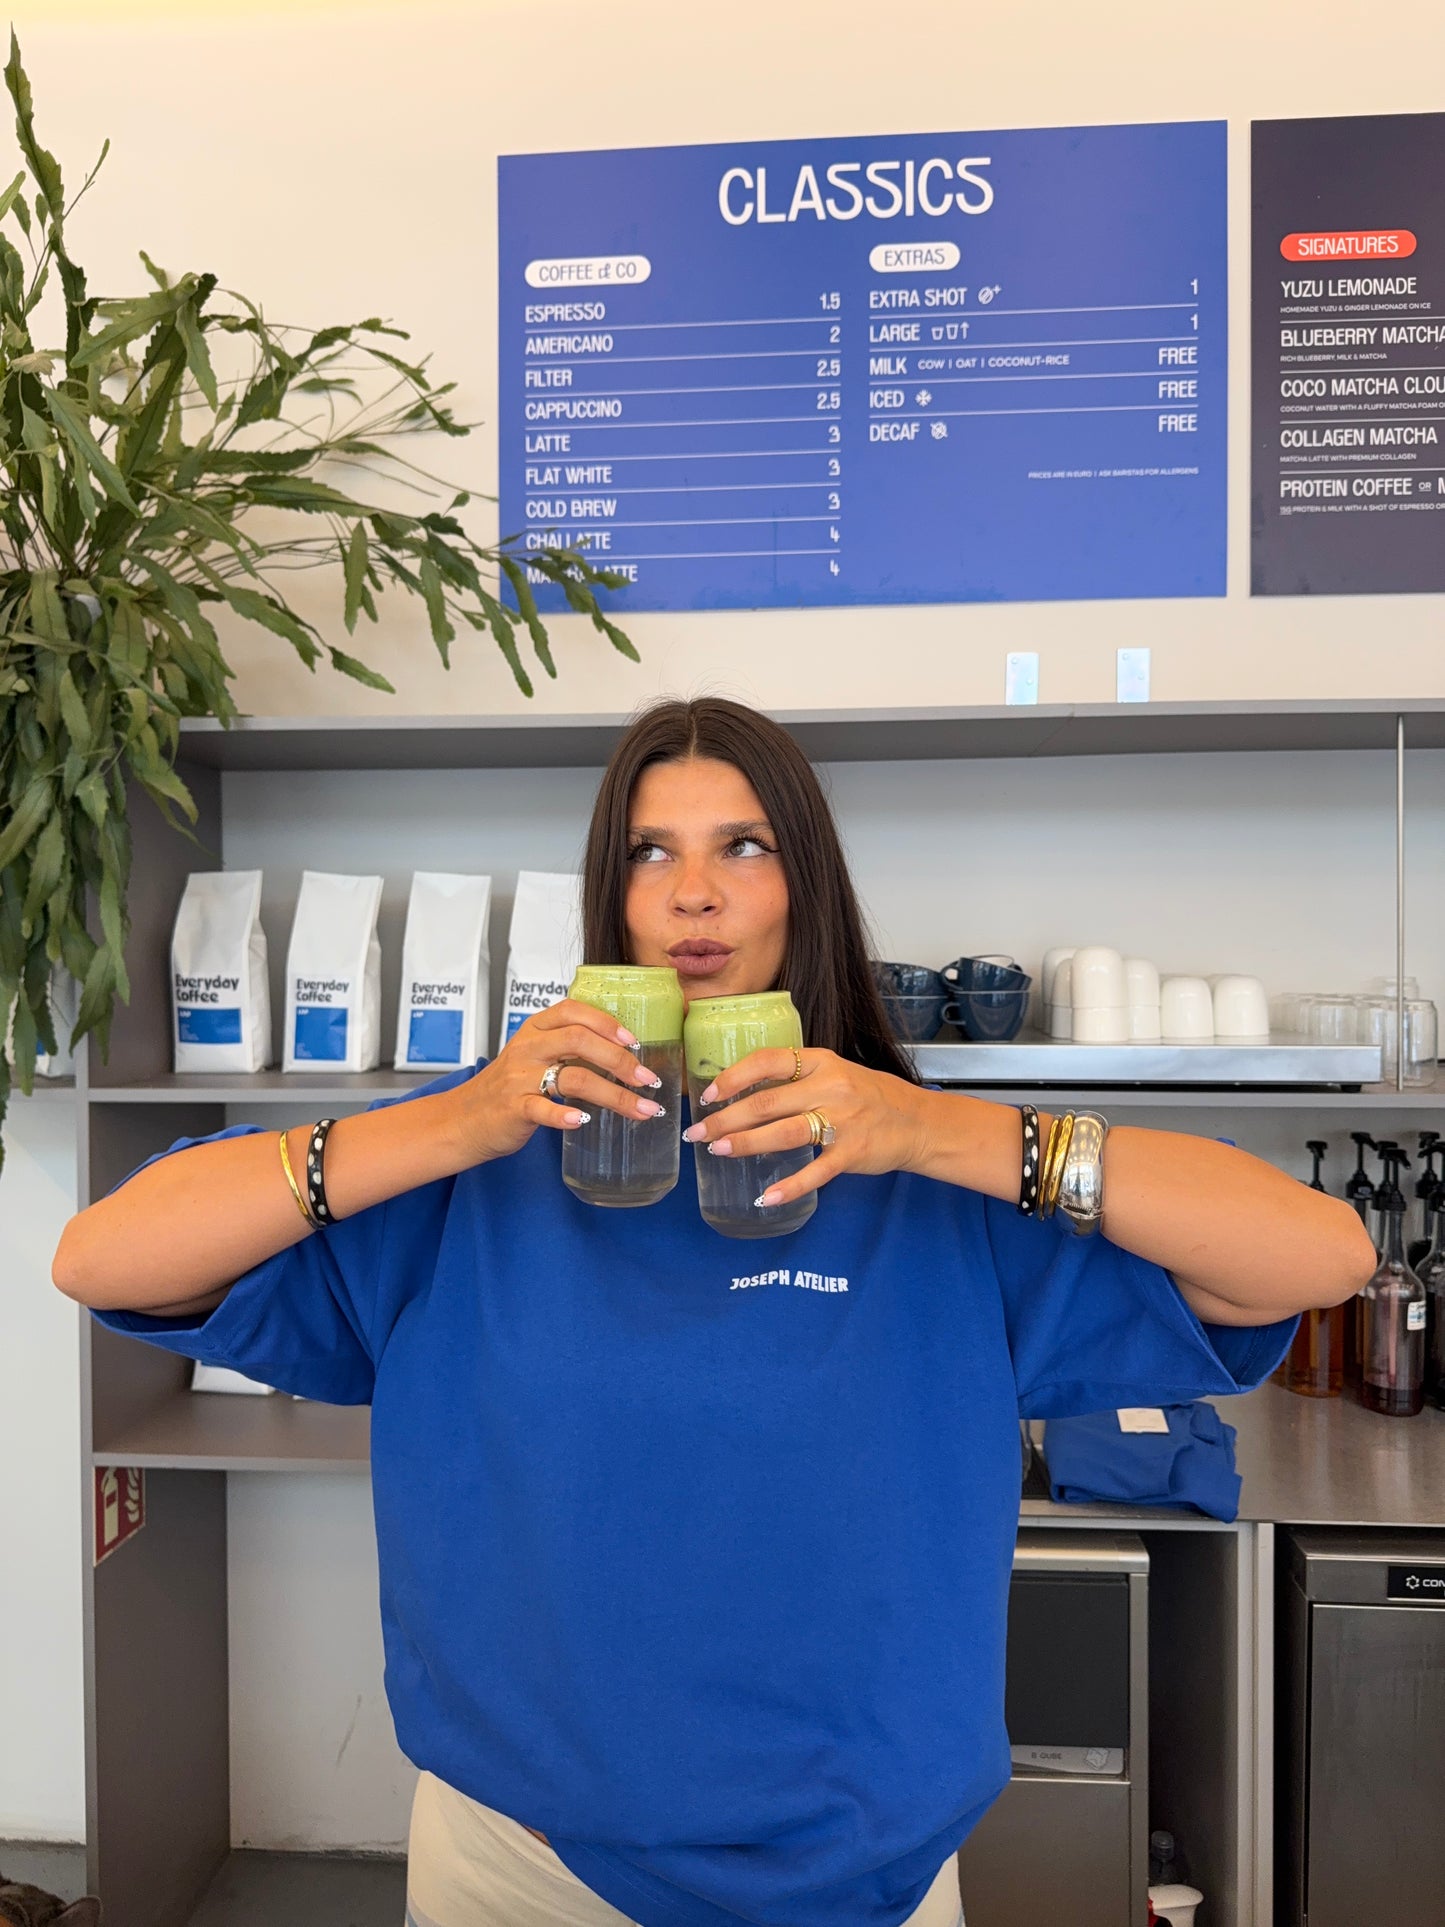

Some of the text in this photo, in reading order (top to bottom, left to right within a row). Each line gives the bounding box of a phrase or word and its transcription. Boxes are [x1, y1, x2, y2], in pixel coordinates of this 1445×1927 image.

[718, 157, 994, 225] CLASSICS
[1298, 235, 1399, 256] SIGNATURES
[884, 248, 945, 267] EXTRAS
[539, 264, 593, 281] COFFEE
[616, 261, 637, 278] CO
[1190, 278, 1198, 295] 1
[1281, 277, 1417, 298] YUZU LEMONADE
[819, 292, 841, 310] 1.5
[869, 287, 967, 308] EXTRA SHOT
[1370, 303, 1408, 311] LEMONADE
[525, 302, 606, 323] ESPRESSO
[1190, 314, 1198, 330] 1
[829, 325, 841, 343] 2
[869, 324, 920, 343] LARGE
[1281, 327, 1378, 347] BLUEBERRY
[525, 334, 614, 355] AMERICANO
[869, 357, 907, 376] MILK
[918, 359, 945, 370] COW
[955, 357, 977, 369] OAT
[988, 354, 1070, 368] COCONUT-RICE
[1158, 346, 1197, 365] FREE
[816, 359, 841, 377] 2.5
[525, 368, 573, 388] FILTER
[1280, 376, 1445, 398] COCO MATCHA CLOU
[869, 390, 904, 408] ICED
[1158, 380, 1197, 399] FREE
[525, 399, 622, 420] CAPPUCCINO
[816, 391, 841, 410] 2.5
[1280, 405, 1313, 413] COCONUT
[1389, 402, 1417, 410] MATCHA
[869, 422, 920, 442] DECAF
[1158, 414, 1197, 432] FREE
[525, 434, 571, 453] LATTE
[828, 425, 841, 443] 3
[1280, 426, 1438, 448] COLLAGEN MATCHA
[828, 458, 841, 476] 3
[1280, 455, 1308, 463] MATCHA
[1308, 454, 1329, 462] LATTE
[1330, 454, 1348, 462] WITH
[525, 466, 613, 486] FLAT WHITE
[1280, 478, 1348, 498] PROTEIN
[1352, 477, 1412, 497] COFFEE
[1418, 482, 1432, 490] OR
[525, 498, 617, 519] COLD BREW
[828, 492, 841, 510] 3
[1344, 504, 1362, 512] WITH
[1389, 503, 1399, 511] OF
[1399, 503, 1435, 511] ESPRESSO
[525, 532, 562, 550] CHAI
[830, 525, 840, 543] 4
[830, 558, 840, 576] 4
[175, 973, 240, 991] Everyday
[296, 978, 350, 993] Everyday
[412, 982, 466, 996] Everyday
[510, 978, 569, 997] Everyday
[176, 988, 219, 1003] Coffee
[296, 991, 333, 1003] Coffee
[411, 993, 448, 1005] Coffee
[509, 994, 551, 1008] Coffee
[729, 1269, 849, 1293] JOSEPH ATELIER
